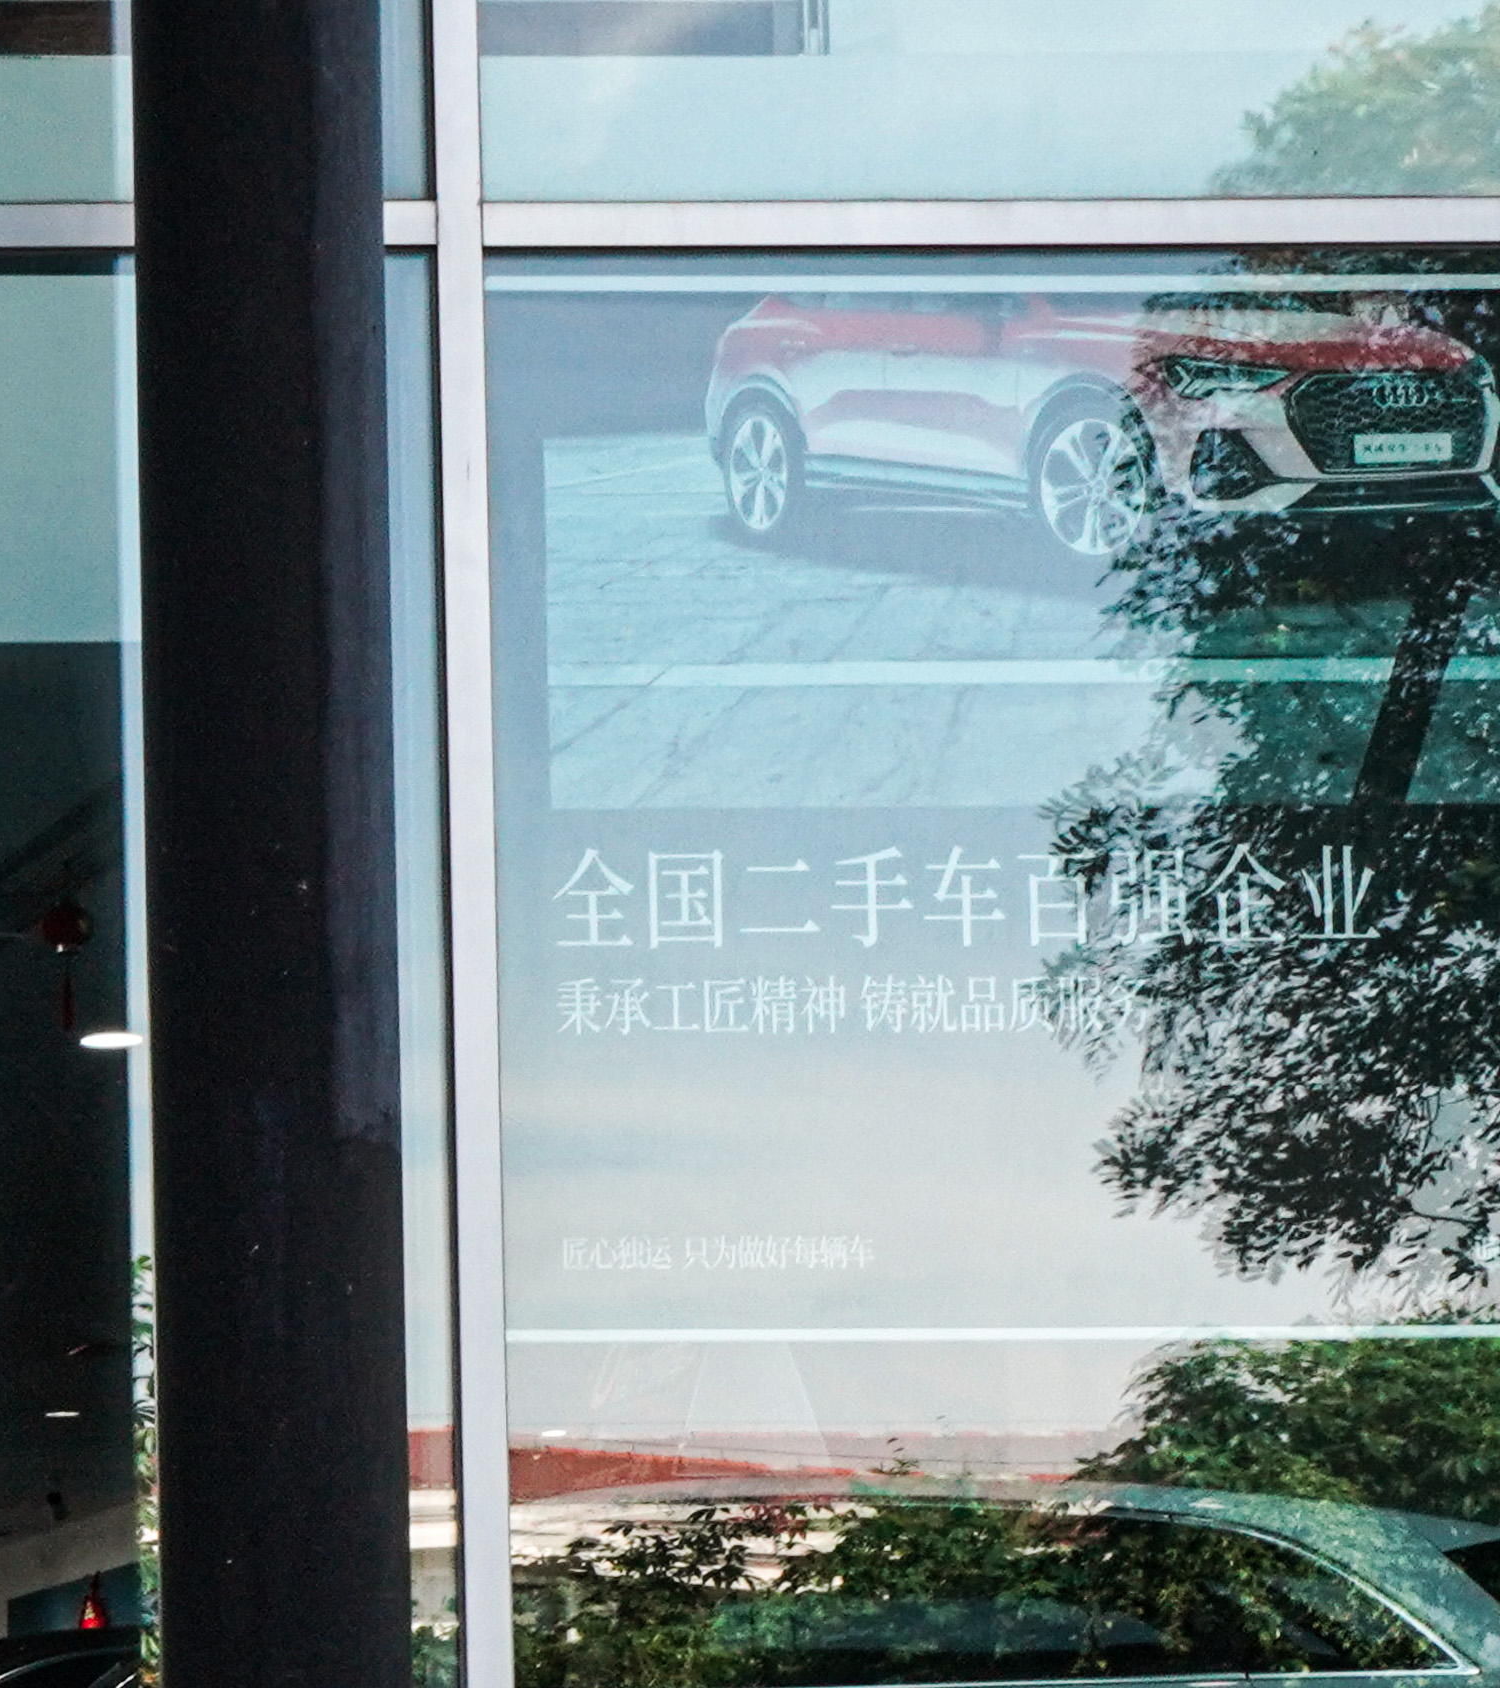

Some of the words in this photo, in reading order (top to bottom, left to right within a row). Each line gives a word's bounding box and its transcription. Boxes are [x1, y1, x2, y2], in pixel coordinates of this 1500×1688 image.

[551, 844, 1382, 951] 全国二手车百强企业
[556, 975, 847, 1036] 秉承工匠精神
[860, 973, 1151, 1036] 铸就品质服务
[562, 1236, 673, 1270] 匠心独运
[683, 1233, 876, 1271] 只为做好每辆车
